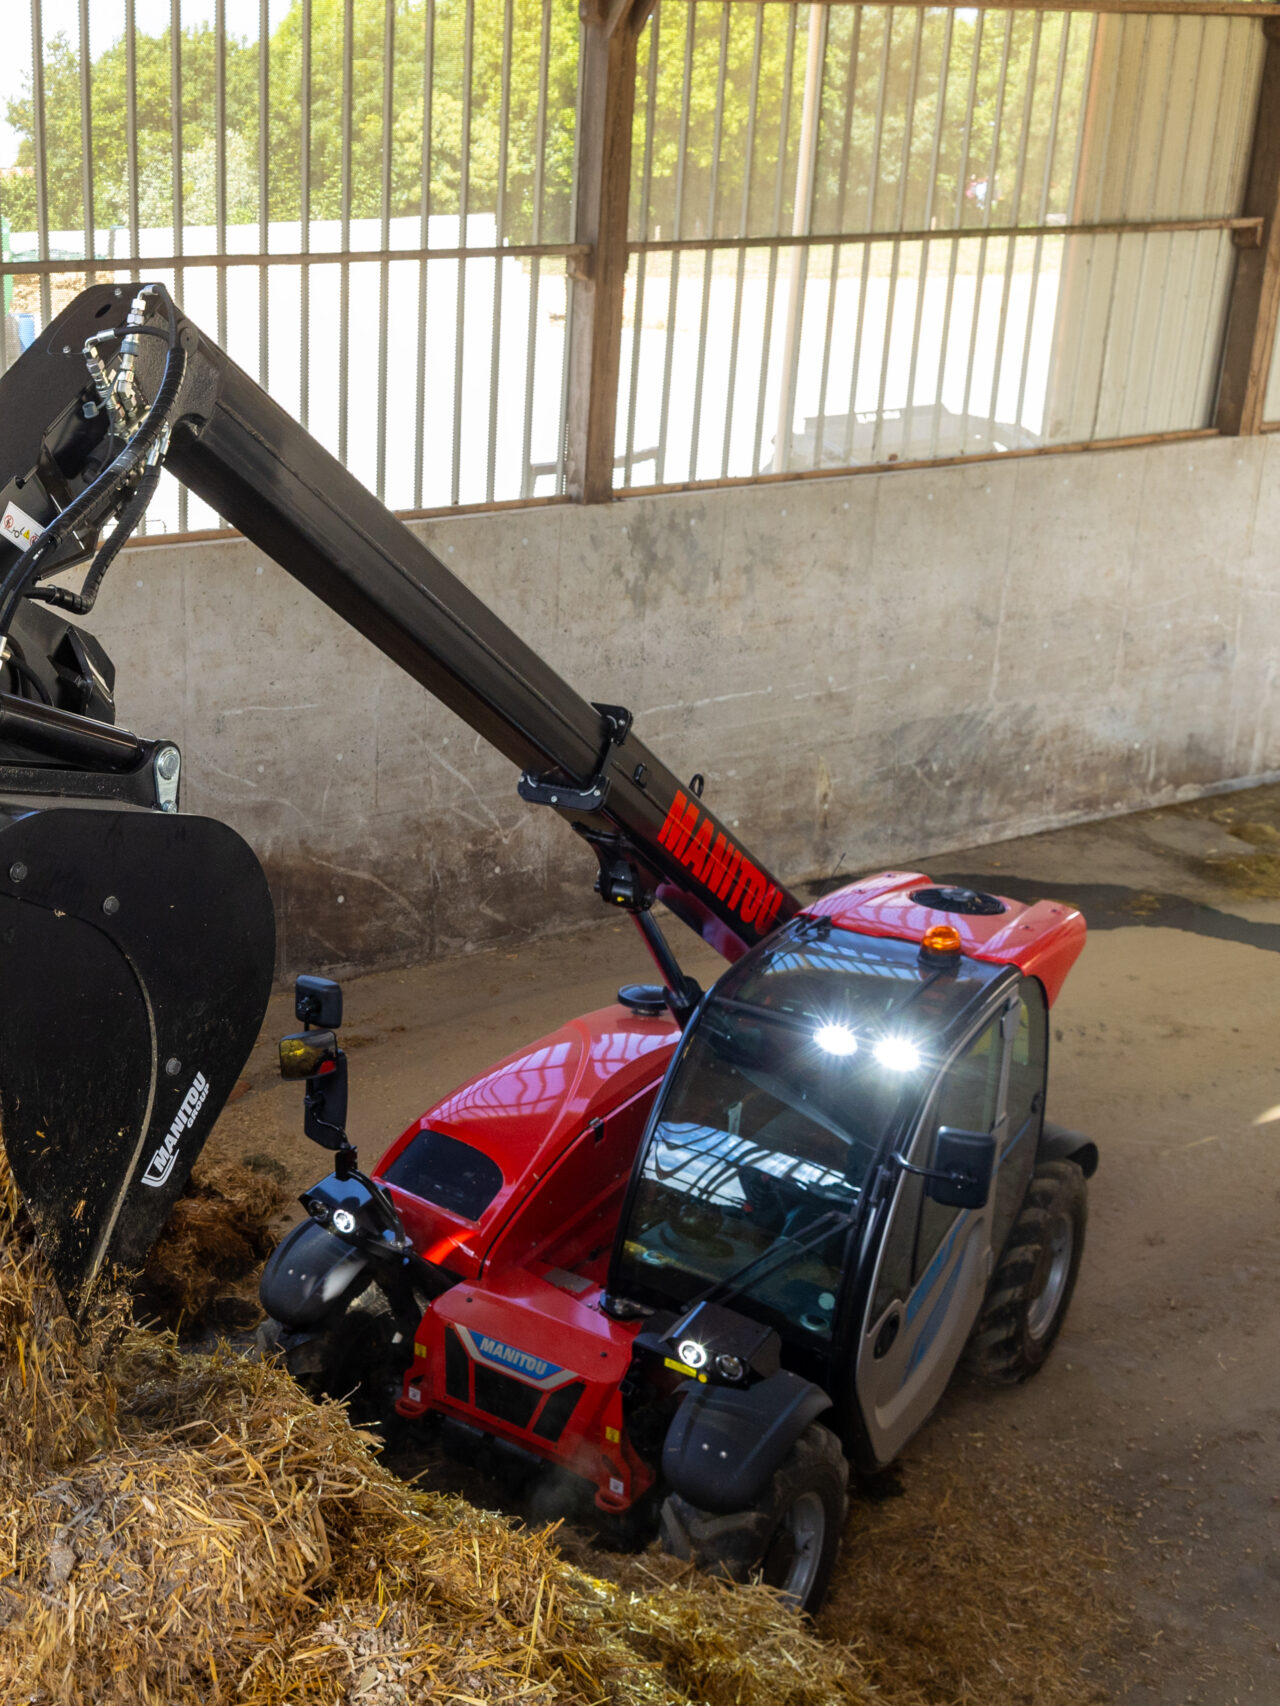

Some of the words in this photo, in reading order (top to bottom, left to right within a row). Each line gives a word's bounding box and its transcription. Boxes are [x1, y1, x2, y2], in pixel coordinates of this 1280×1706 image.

[657, 789, 783, 936] MANITOU
[153, 1071, 206, 1173] MANITOU
[187, 1082, 210, 1128] GROUP
[480, 1337, 548, 1375] MANITOU
